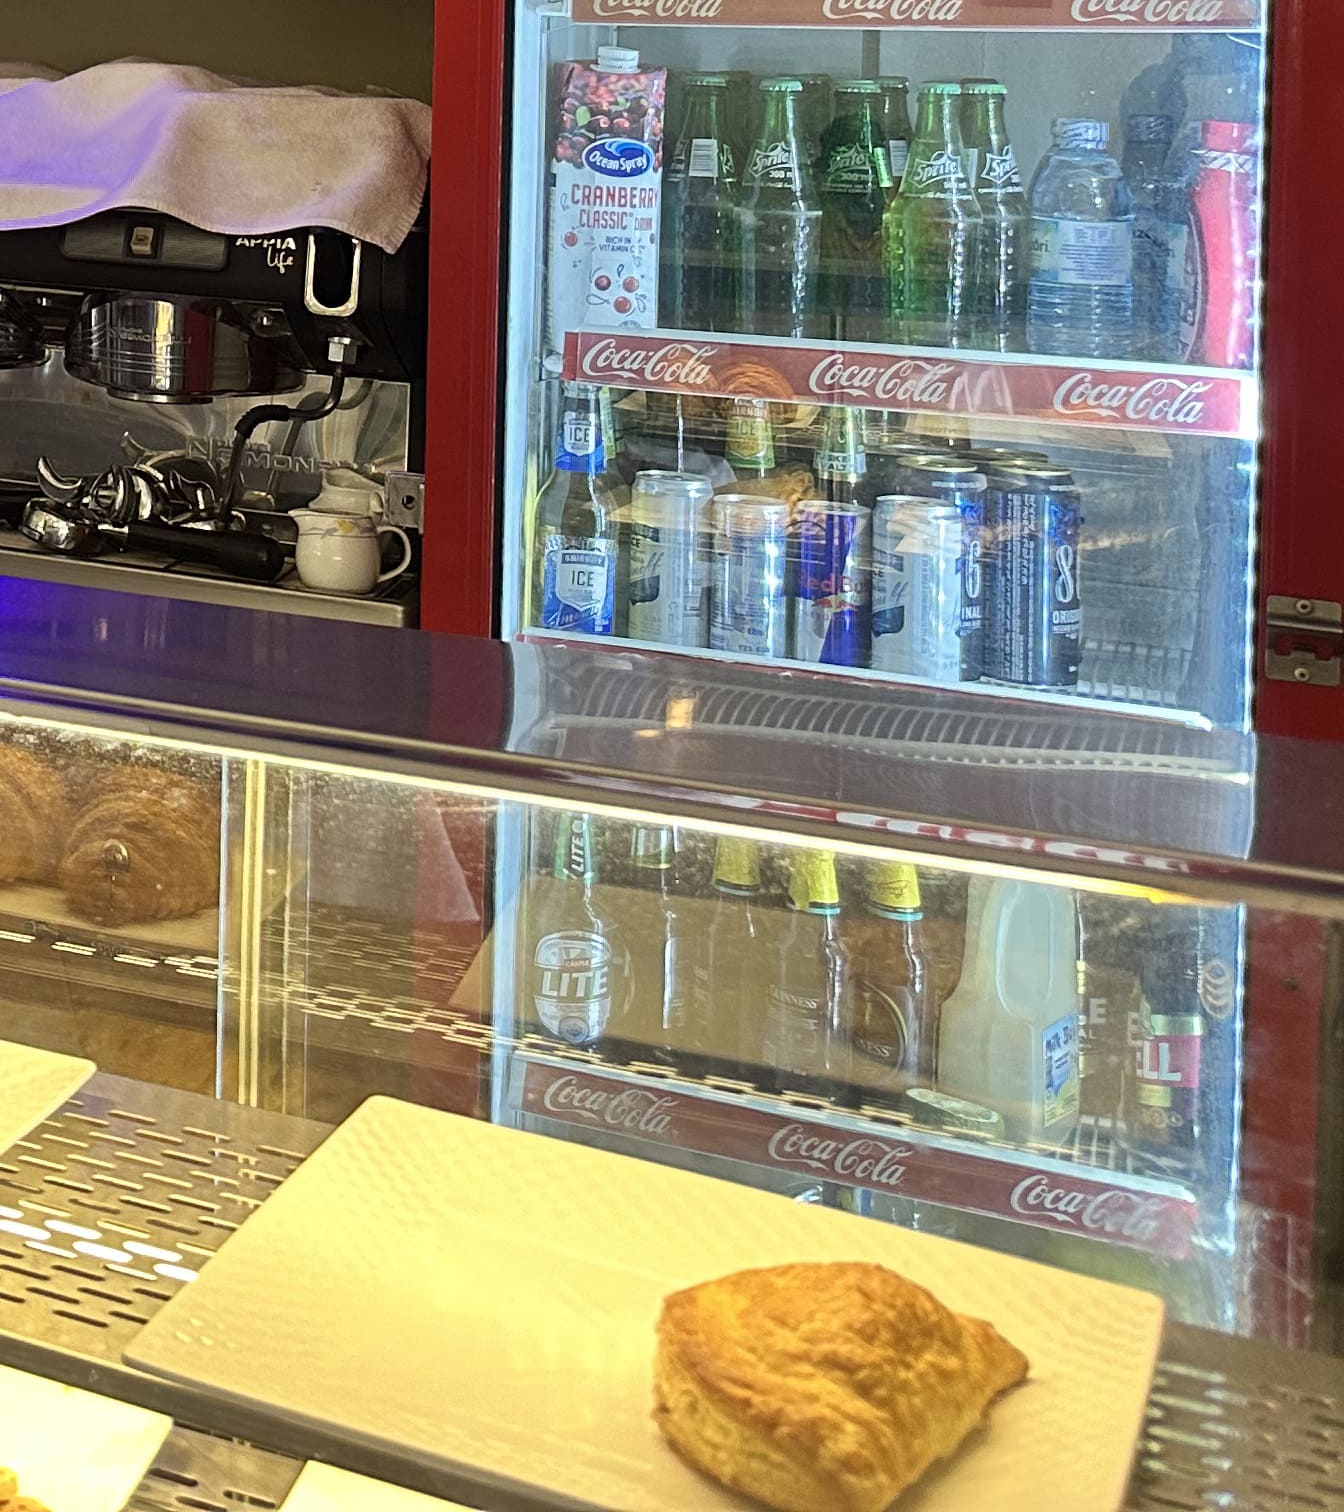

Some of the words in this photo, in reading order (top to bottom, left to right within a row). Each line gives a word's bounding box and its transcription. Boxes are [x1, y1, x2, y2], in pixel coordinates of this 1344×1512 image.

[588, 150, 620, 171] Ocean
[619, 153, 648, 174] Spray
[752, 145, 791, 171] Sprite
[914, 154, 961, 182] Sprite
[266, 248, 296, 274] life
[581, 338, 719, 385] Coca-Cola
[809, 353, 957, 404] Coca-Cola
[1052, 372, 1207, 424] Coca-Cola
[568, 426, 591, 442] ICE
[570, 570, 596, 587] ICE
[570, 835, 586, 873] LITE
[540, 967, 609, 999] LITE
[543, 1074, 677, 1136] Coca-Cola
[768, 1122, 912, 1187] Coca-Cola
[1010, 1174, 1163, 1242] Coca-Cola
